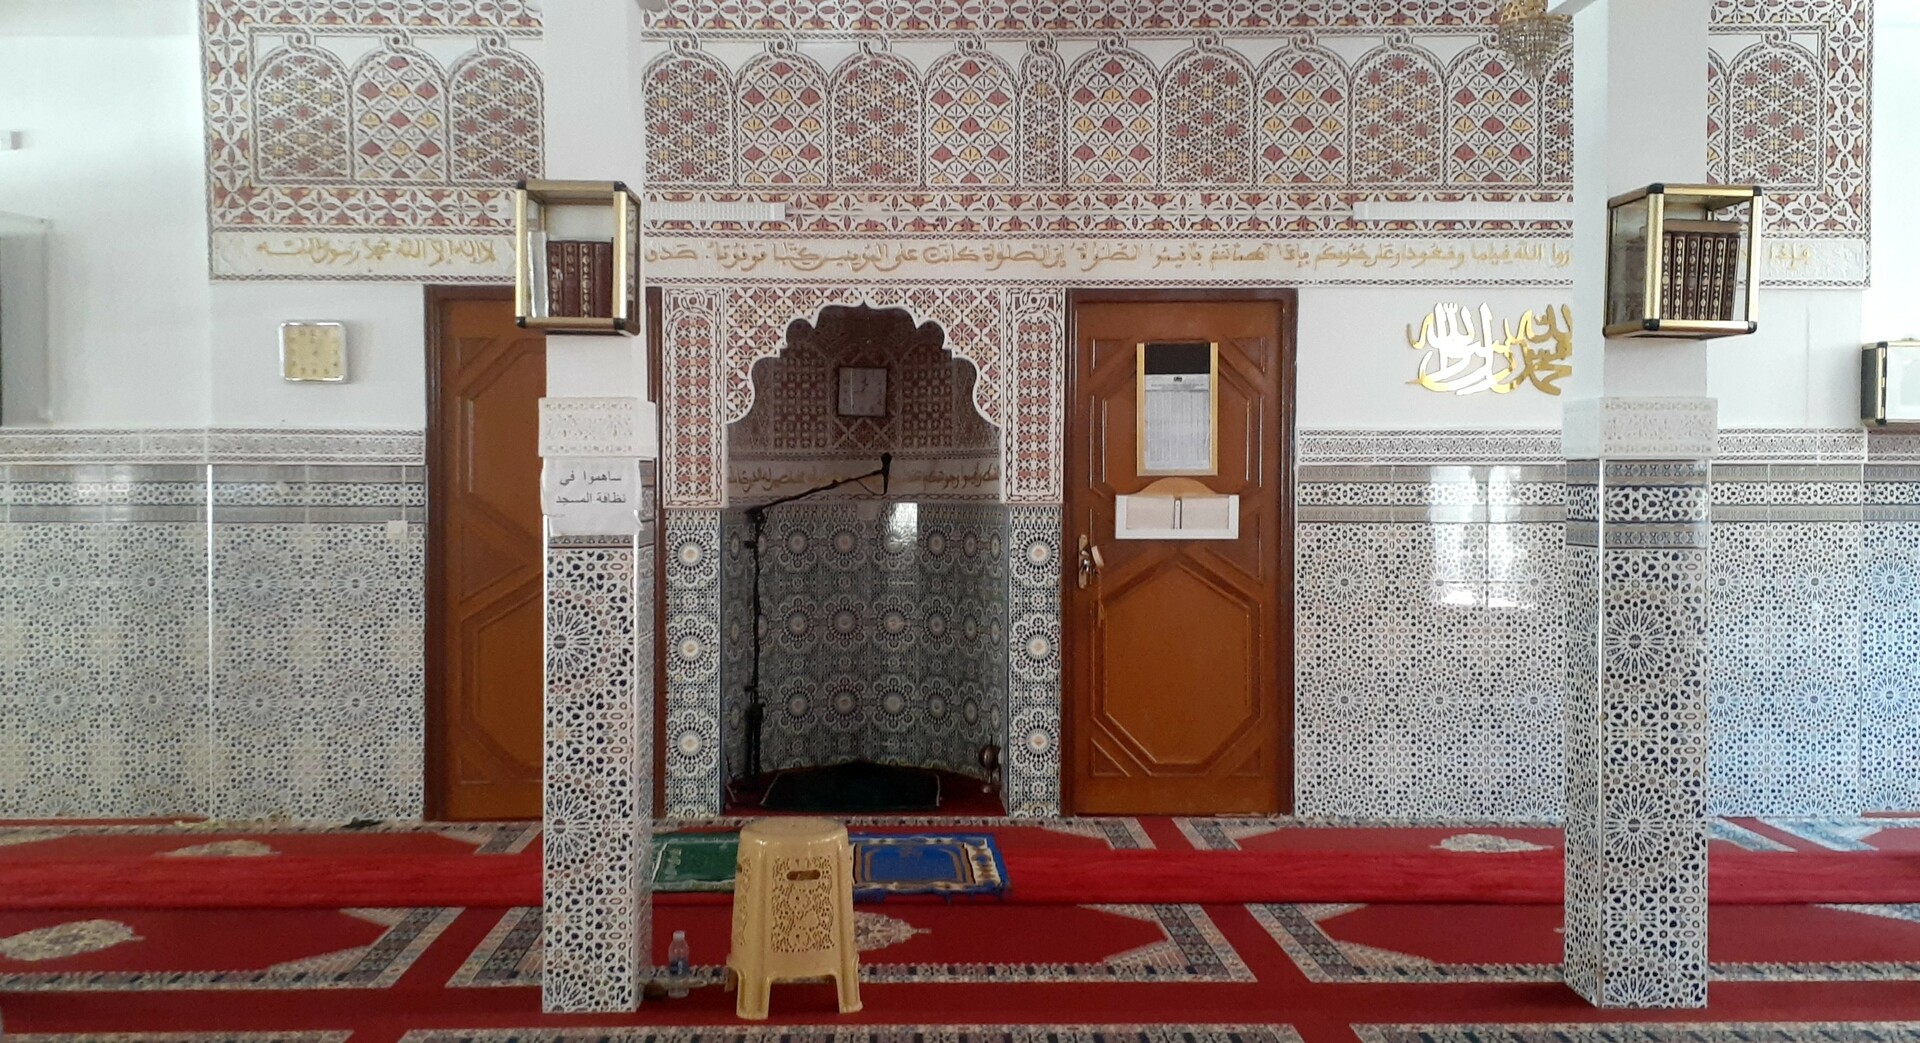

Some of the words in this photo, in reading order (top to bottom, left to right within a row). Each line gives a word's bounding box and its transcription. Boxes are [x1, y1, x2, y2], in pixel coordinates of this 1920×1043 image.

[583, 470, 622, 485] ساهموا
[556, 491, 592, 506] المسجد
[596, 491, 626, 504] نظافة
